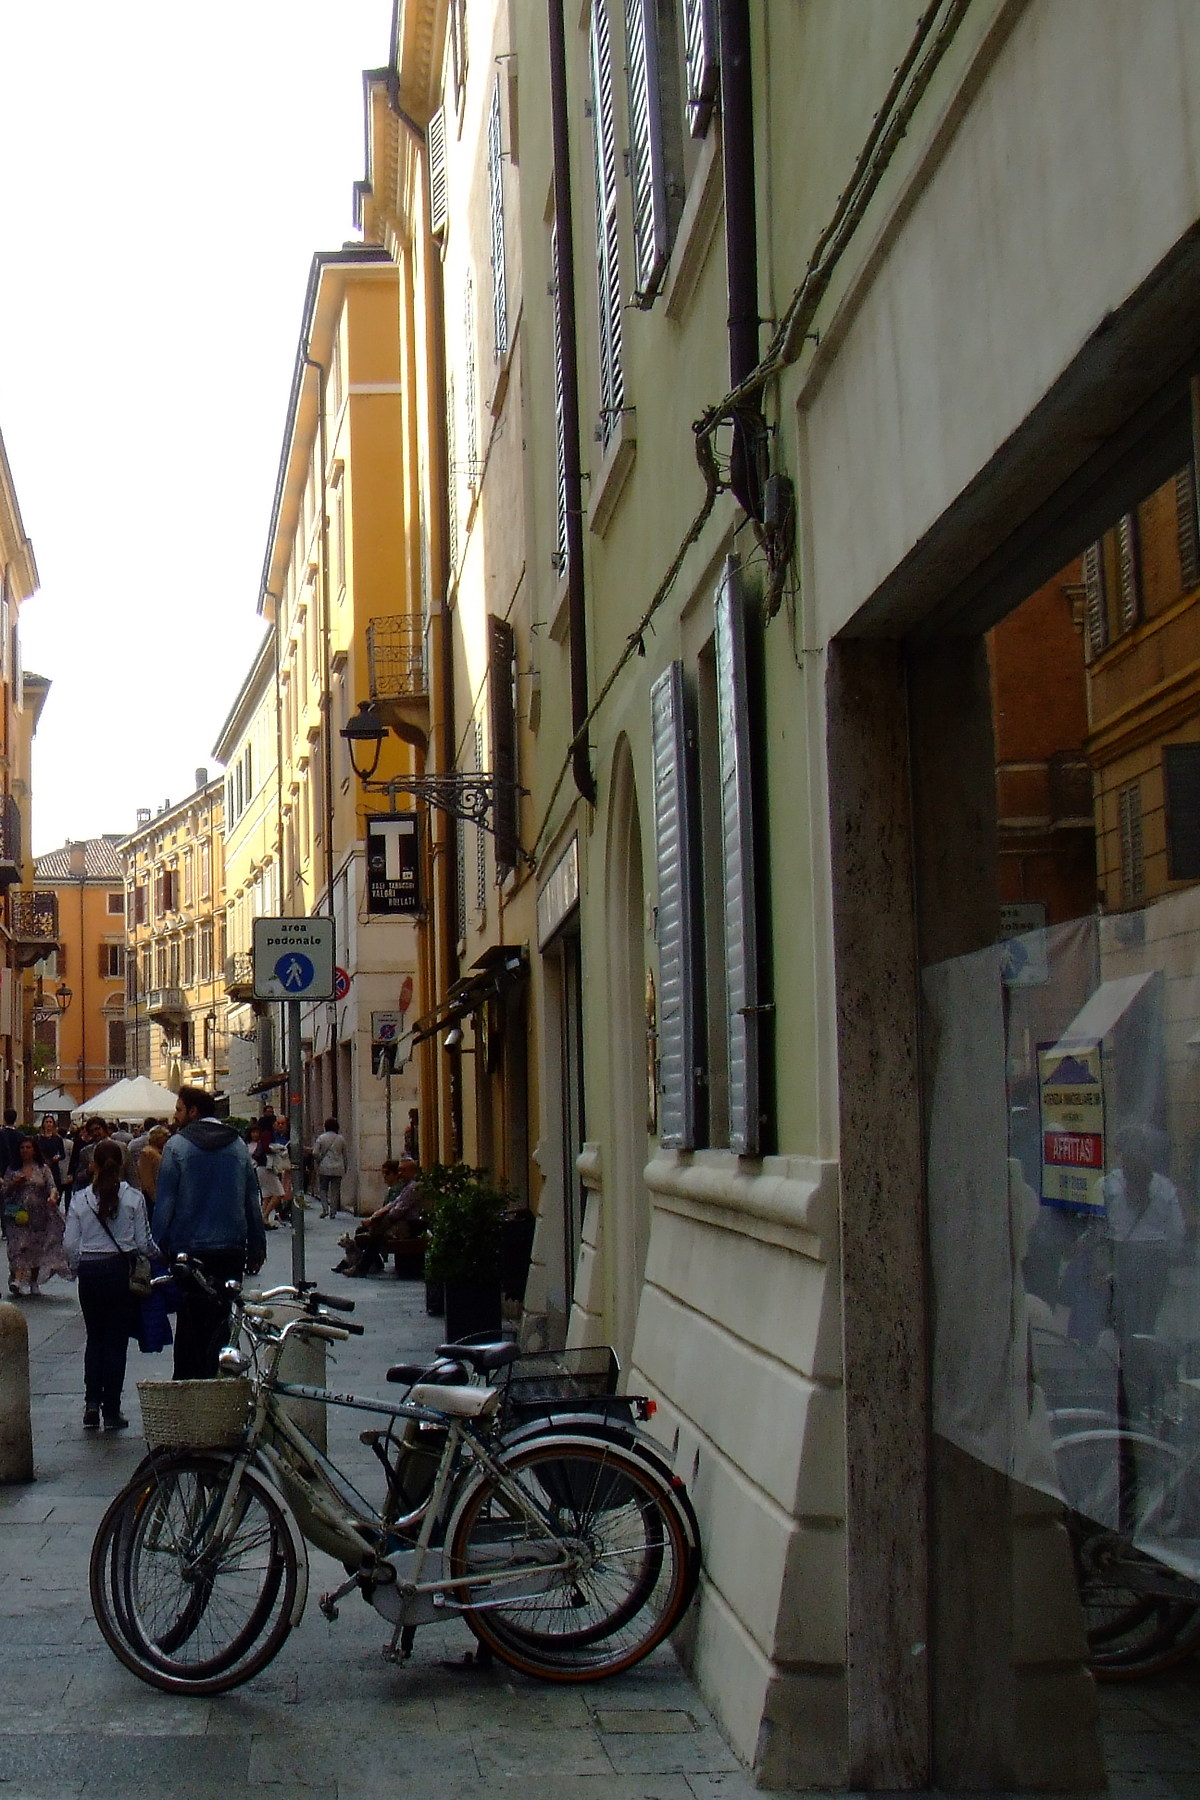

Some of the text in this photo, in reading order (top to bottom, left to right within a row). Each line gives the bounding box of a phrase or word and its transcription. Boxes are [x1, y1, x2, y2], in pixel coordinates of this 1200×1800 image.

[369, 820, 415, 881] T
[371, 889, 396, 898] VALORI
[281, 924, 307, 932] area
[267, 935, 321, 946] pedonale
[1053, 1137, 1093, 1162] AFFITTASI
